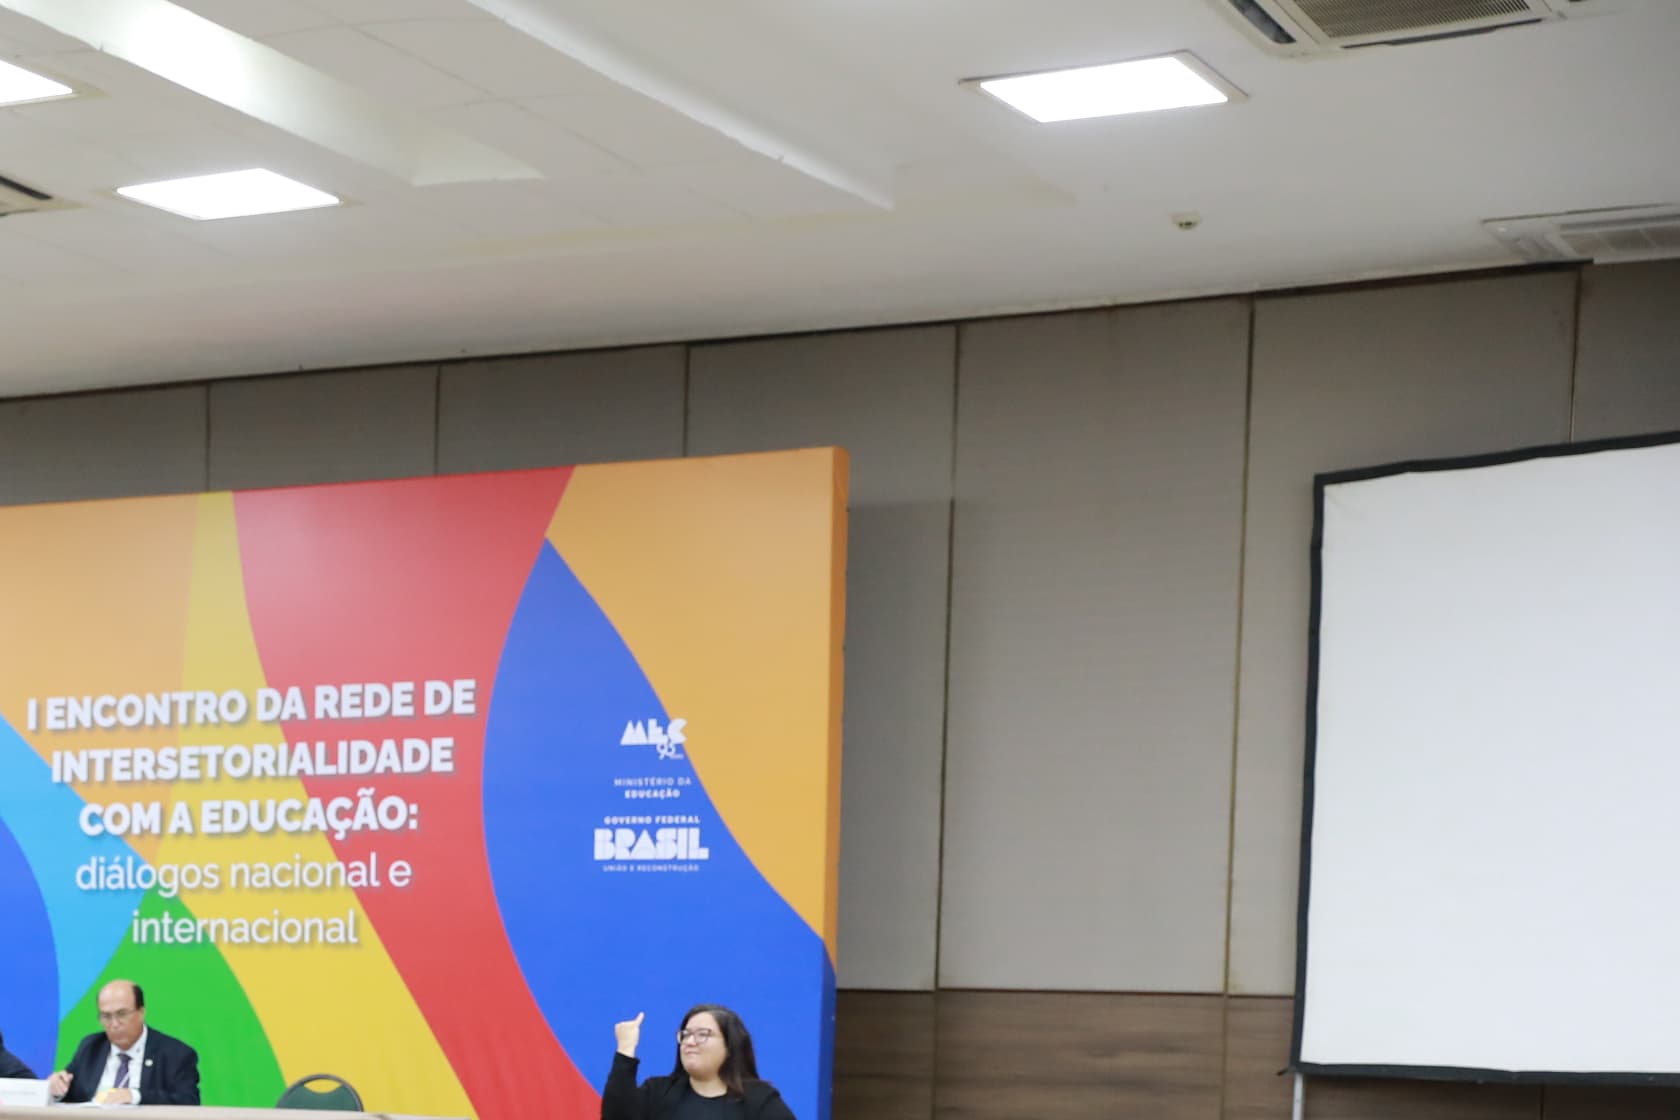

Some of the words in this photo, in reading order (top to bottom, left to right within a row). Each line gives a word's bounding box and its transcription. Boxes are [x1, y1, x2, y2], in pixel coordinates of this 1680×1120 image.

[27, 698, 37, 731] I
[46, 688, 248, 730] ENCONTRO
[255, 686, 307, 721] DA
[315, 681, 415, 719] REDE
[424, 679, 477, 716] DE
[620, 718, 688, 746] MEC
[51, 737, 455, 783] INTERSETORIALIDADE
[614, 776, 674, 787] MINISTÉRIO
[677, 776, 692, 786] DA
[624, 787, 681, 800] EDUCAÇÃO
[78, 801, 162, 836] COM
[168, 800, 193, 834] A
[201, 788, 418, 840] EDUCAÇÃO:
[603, 816, 653, 825] GOVERNO
[655, 815, 701, 824] FEDERAL
[593, 827, 710, 861] BRASIL
[75, 855, 220, 897] diálogos
[230, 852, 380, 888] nacional
[388, 860, 412, 886] e
[132, 909, 358, 944] internacional
